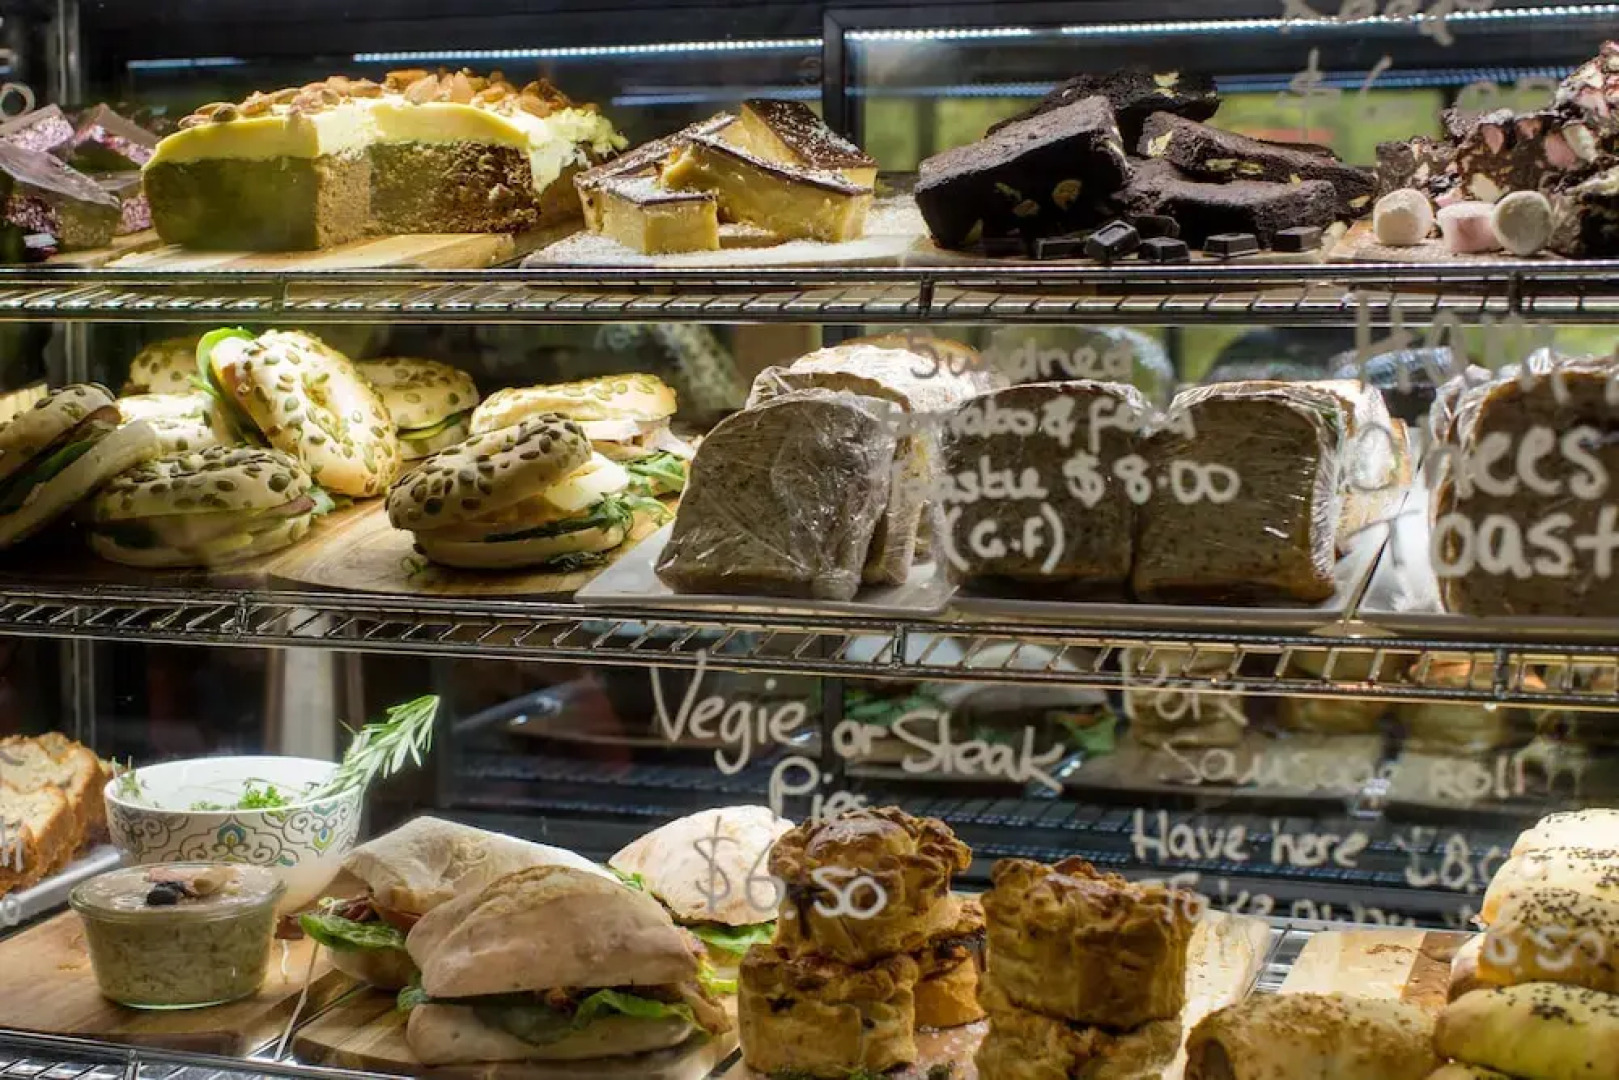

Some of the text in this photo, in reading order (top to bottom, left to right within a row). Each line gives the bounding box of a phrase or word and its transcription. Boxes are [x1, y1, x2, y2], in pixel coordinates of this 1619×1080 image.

[1062, 449, 1241, 508] $8.00
[651, 650, 1066, 794] Vegie or Steak
[693, 814, 888, 921] $6.50
[1130, 808, 1248, 864] Have
[1270, 820, 1370, 868] here
